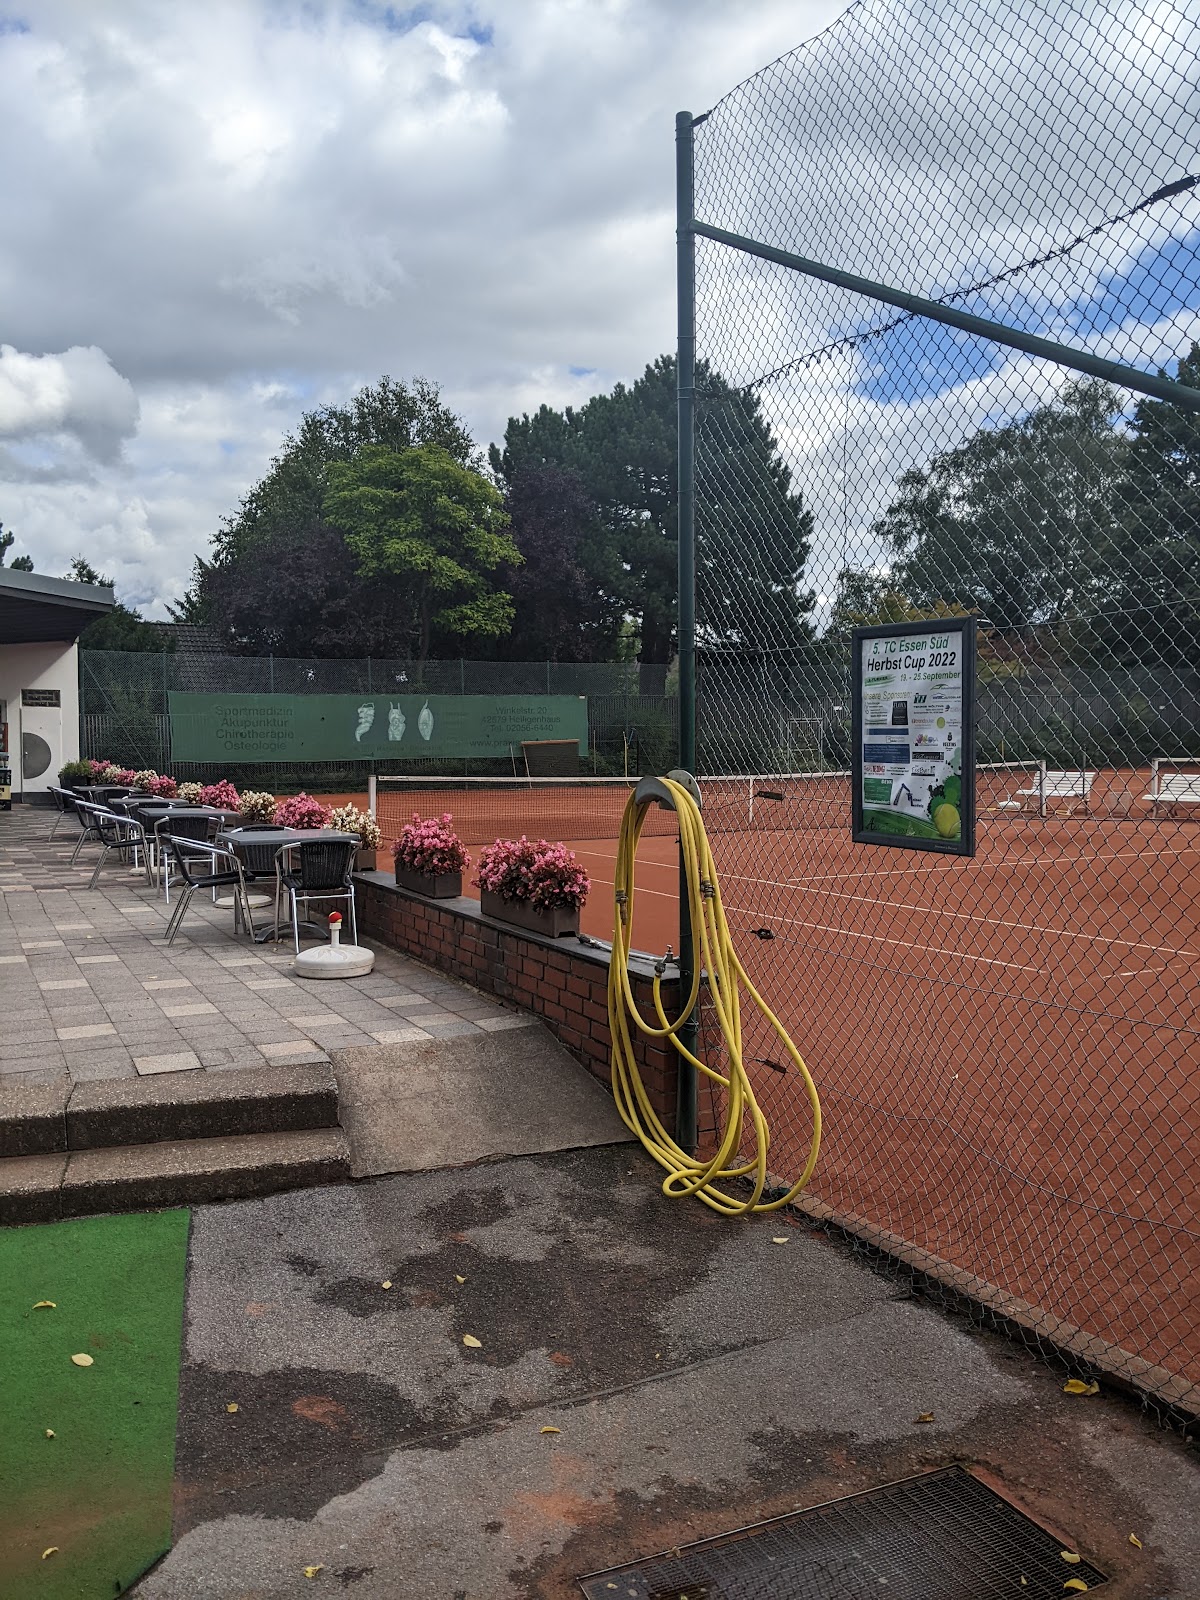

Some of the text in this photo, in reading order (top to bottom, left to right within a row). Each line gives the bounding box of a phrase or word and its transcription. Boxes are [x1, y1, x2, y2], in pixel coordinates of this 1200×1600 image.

[872, 635, 949, 655] 5. TC Essen Süd
[867, 652, 956, 672] Herbst Cup 2022
[215, 705, 293, 718] Sportmedizin
[495, 706, 548, 715] Winkelstr. 20
[220, 718, 289, 729] Akupunktur
[509, 715, 561, 725] Heiligenhaus
[215, 728, 294, 740] Chirotherapie
[224, 740, 287, 752] Osteologie
